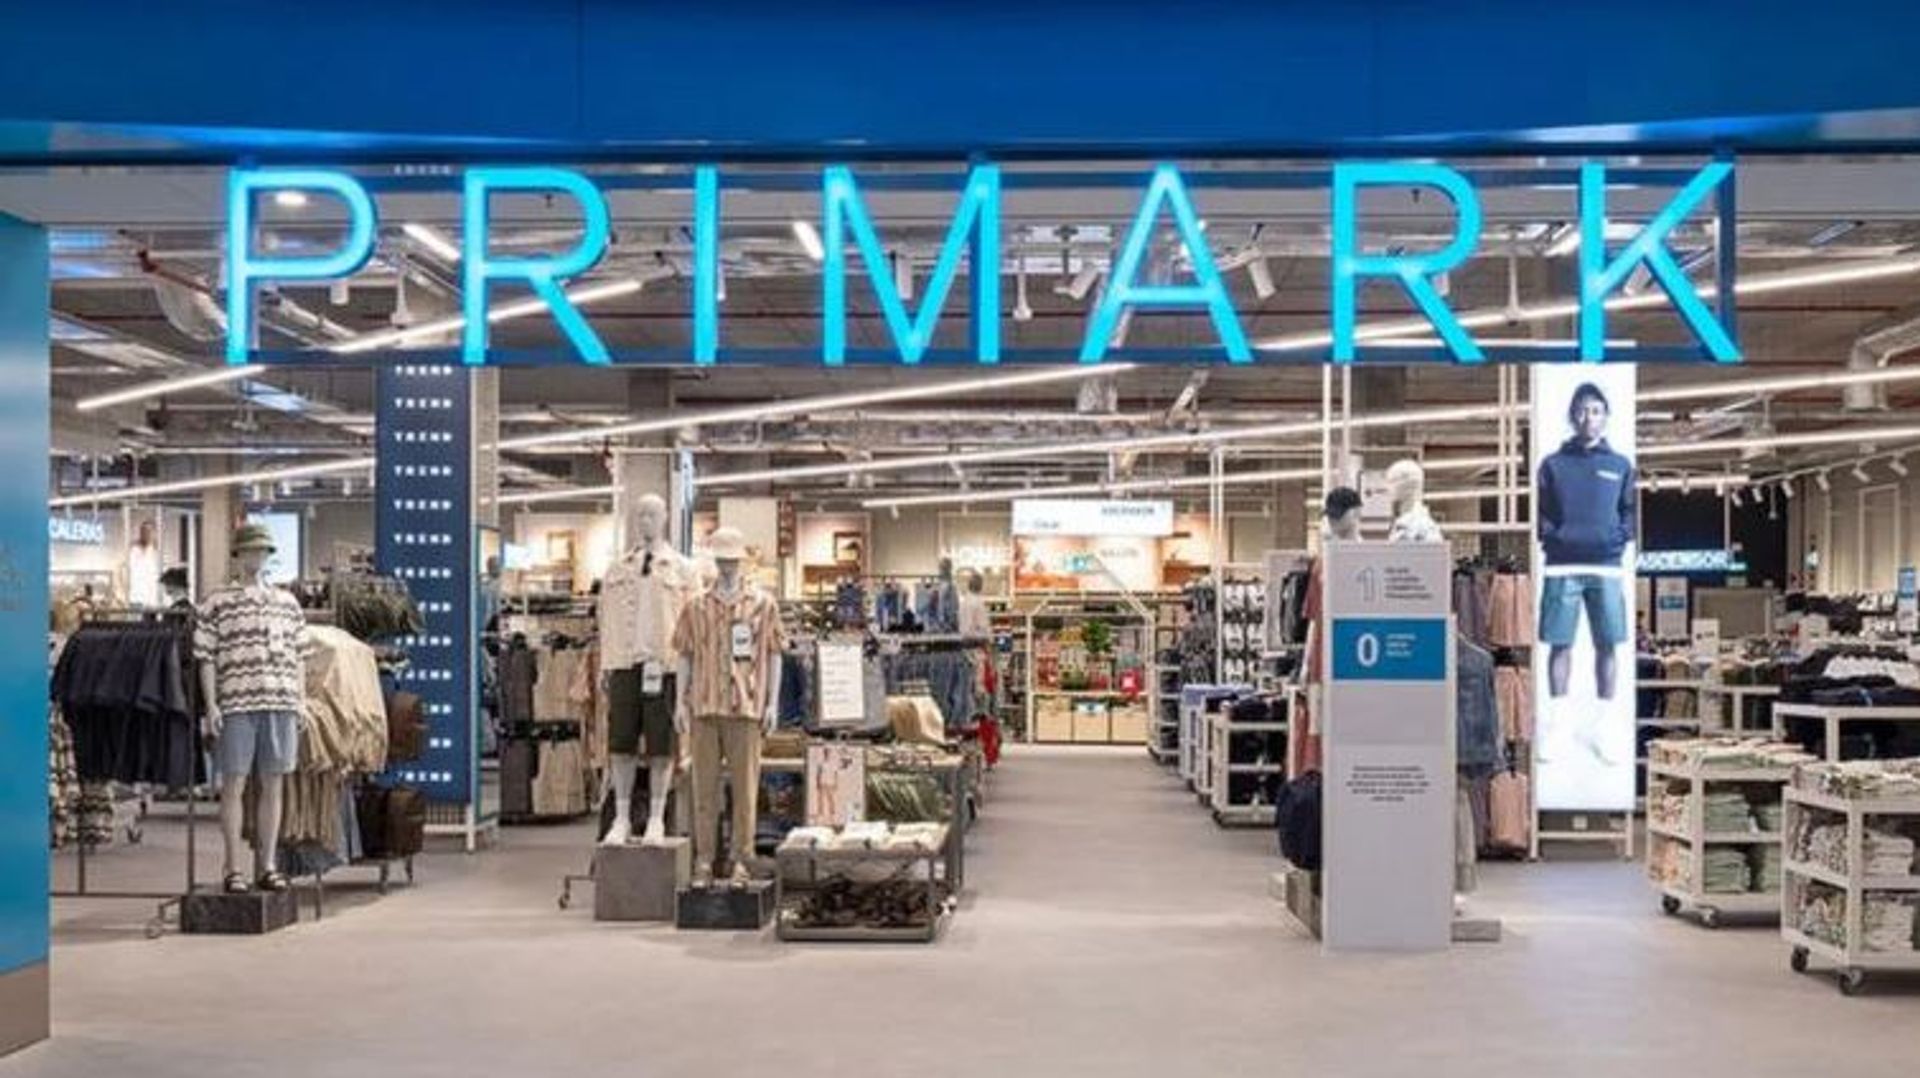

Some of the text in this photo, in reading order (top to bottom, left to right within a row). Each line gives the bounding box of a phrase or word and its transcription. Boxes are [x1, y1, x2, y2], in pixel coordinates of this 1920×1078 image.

[225, 160, 1741, 364] PRIMARK
[395, 398, 452, 408] TREND
[394, 432, 452, 442] TREND
[394, 466, 452, 476] TREND
[394, 500, 452, 510] TREND
[394, 534, 452, 544] TREND
[1358, 633, 1379, 667] 0
